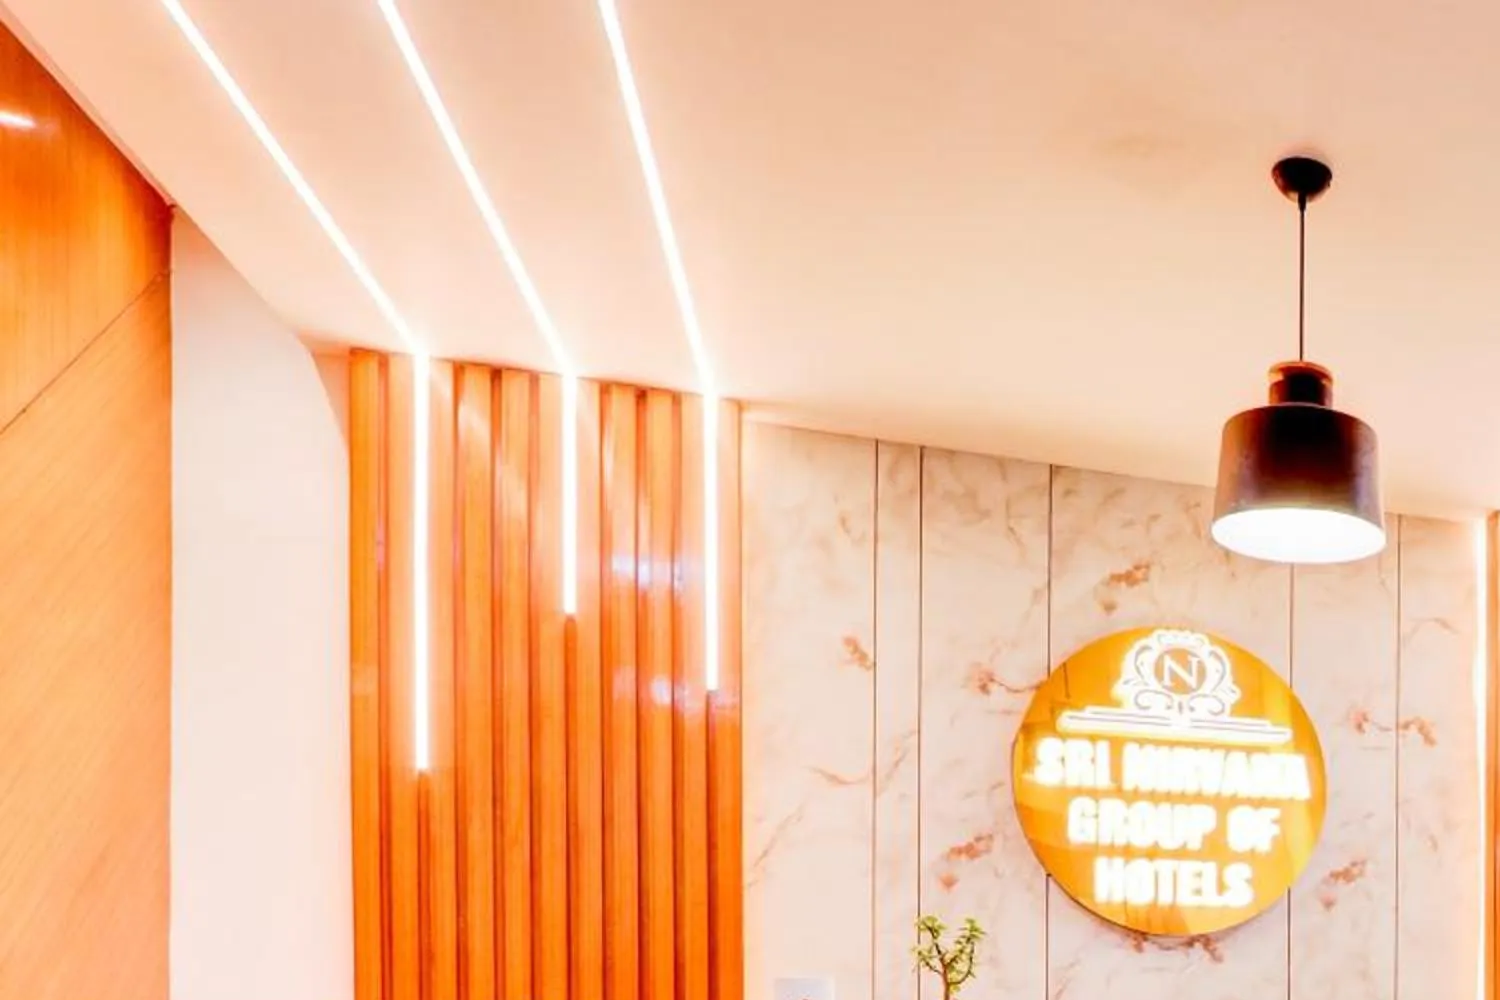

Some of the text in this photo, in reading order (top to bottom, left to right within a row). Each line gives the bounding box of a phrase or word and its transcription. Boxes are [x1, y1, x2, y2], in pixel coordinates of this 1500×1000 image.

[1161, 655, 1201, 689] N
[1034, 737, 1111, 788] SRI
[1067, 796, 1281, 854] GROUP OF
[1093, 856, 1253, 908] HOTELS
